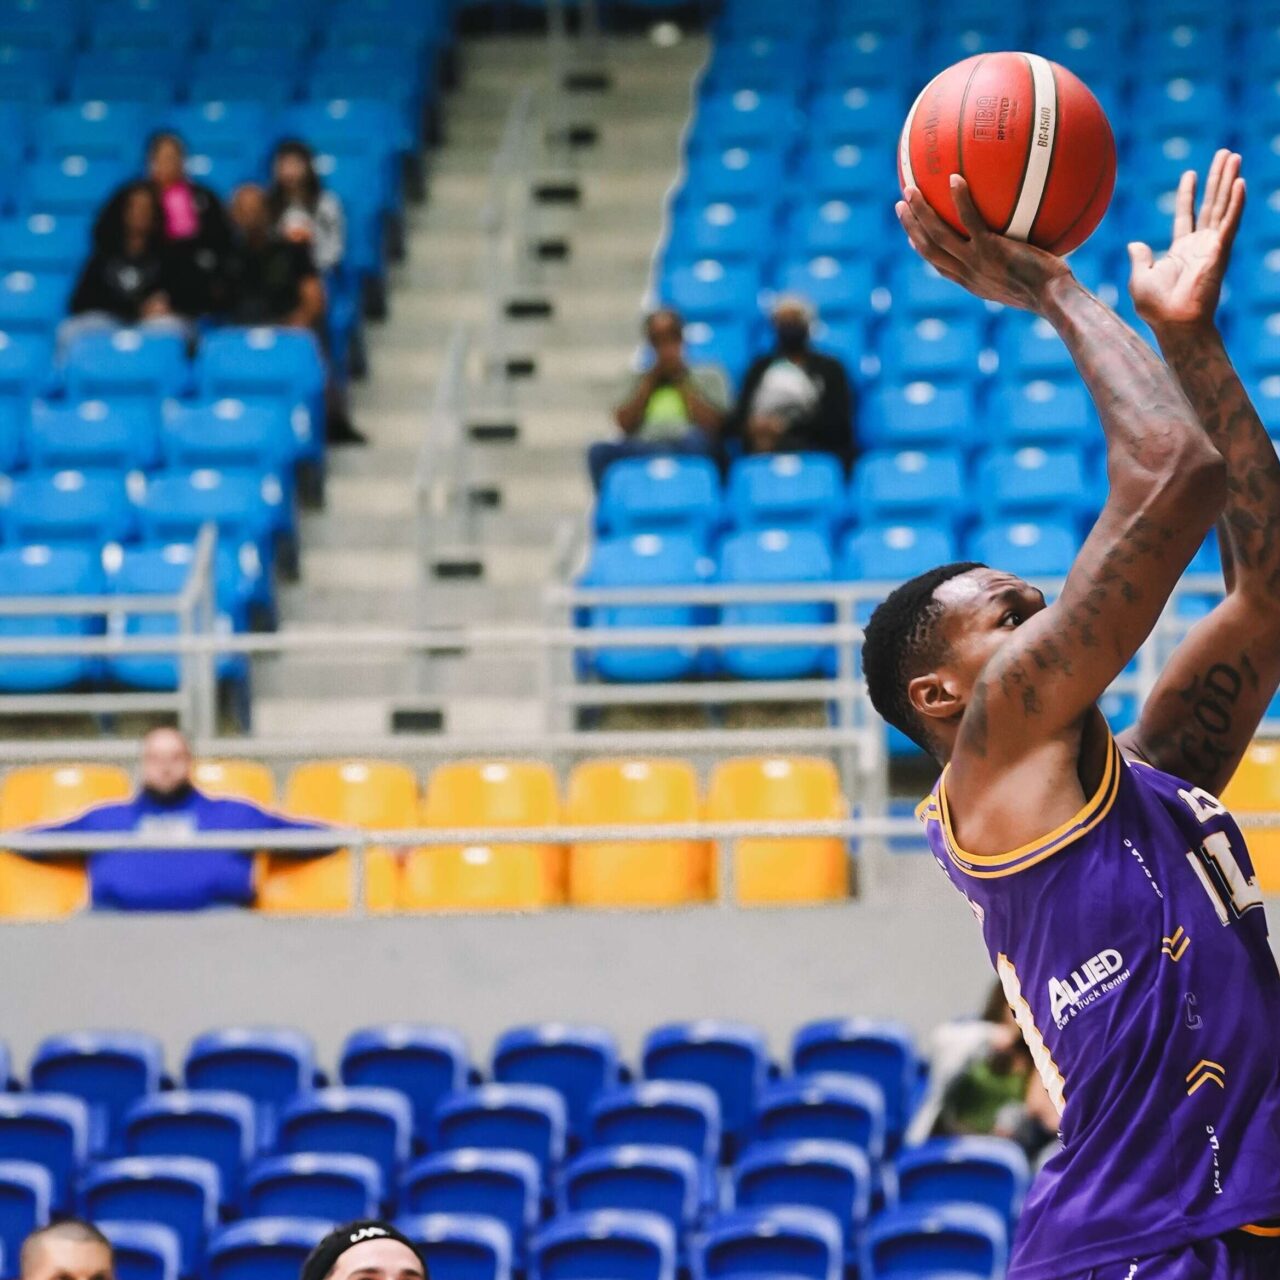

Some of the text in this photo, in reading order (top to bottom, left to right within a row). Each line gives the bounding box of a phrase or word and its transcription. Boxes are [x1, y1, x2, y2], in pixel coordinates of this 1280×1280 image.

[973, 96, 998, 142] FIBA
[997, 97, 1010, 141] APPROVED
[1037, 107, 1051, 148] BG4500
[1048, 949, 1123, 1024] ALLIED
[1101, 968, 1131, 993] Rental
